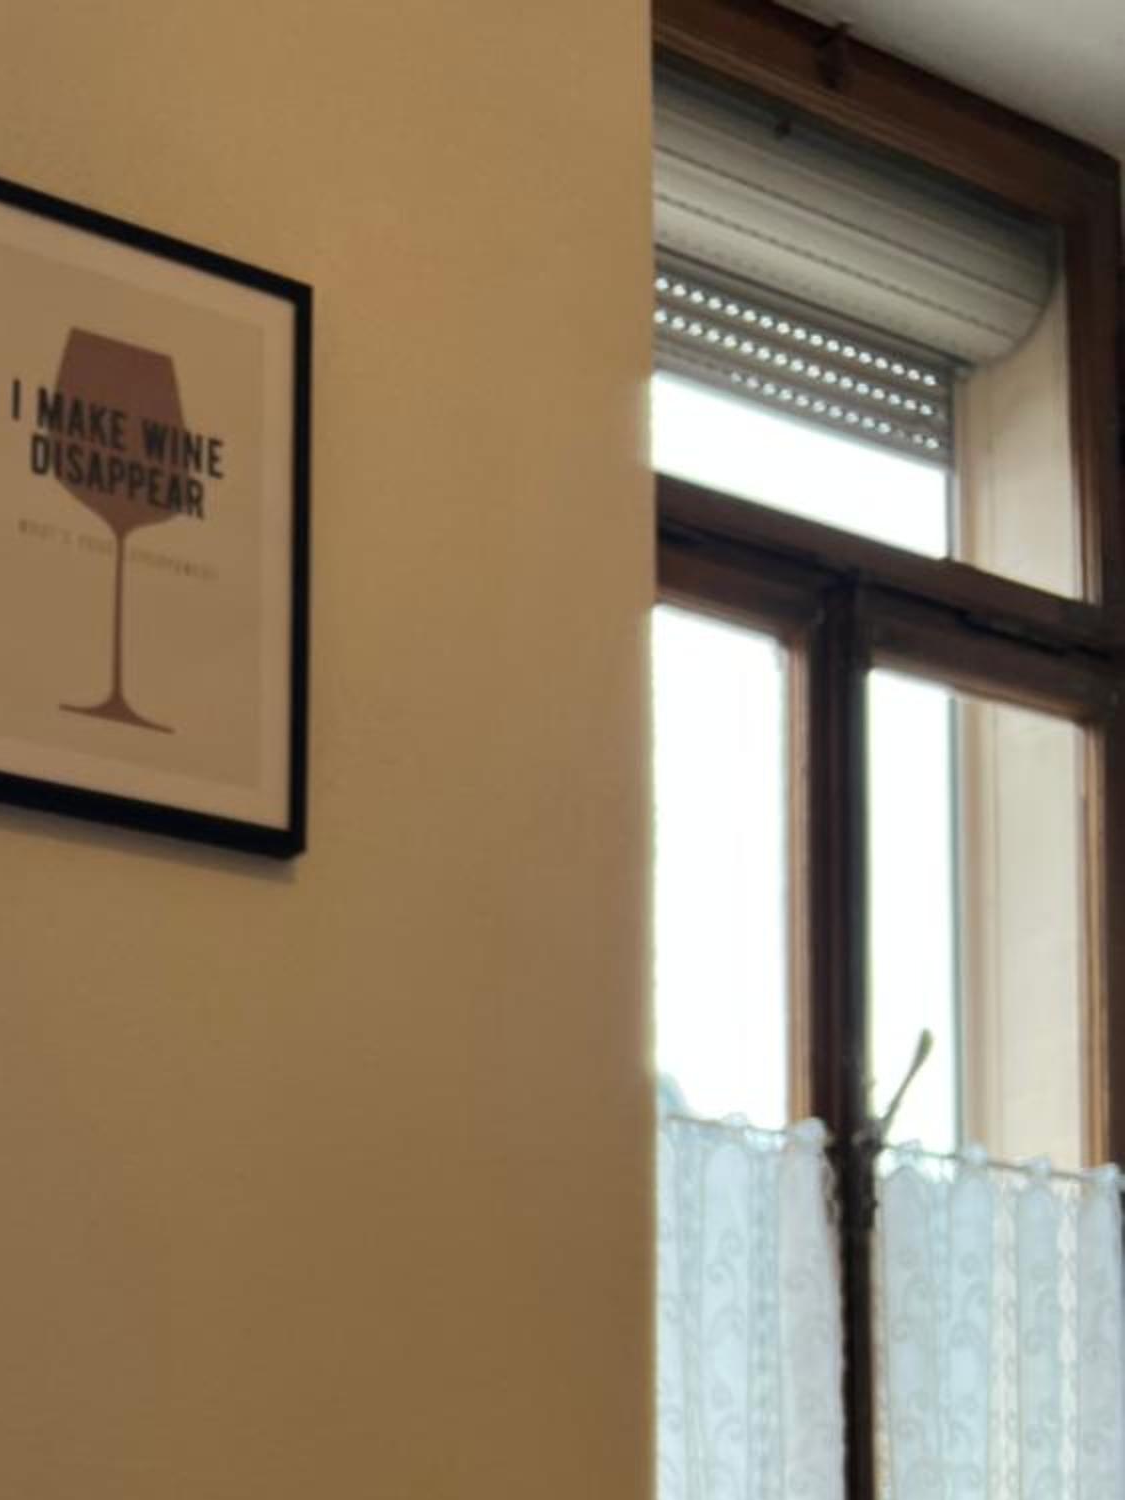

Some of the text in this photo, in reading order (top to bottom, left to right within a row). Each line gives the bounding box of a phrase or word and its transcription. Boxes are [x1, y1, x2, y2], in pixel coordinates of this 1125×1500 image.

[11, 377, 224, 480] I MAKE WINE
[31, 432, 205, 521] DISAPPEAR
